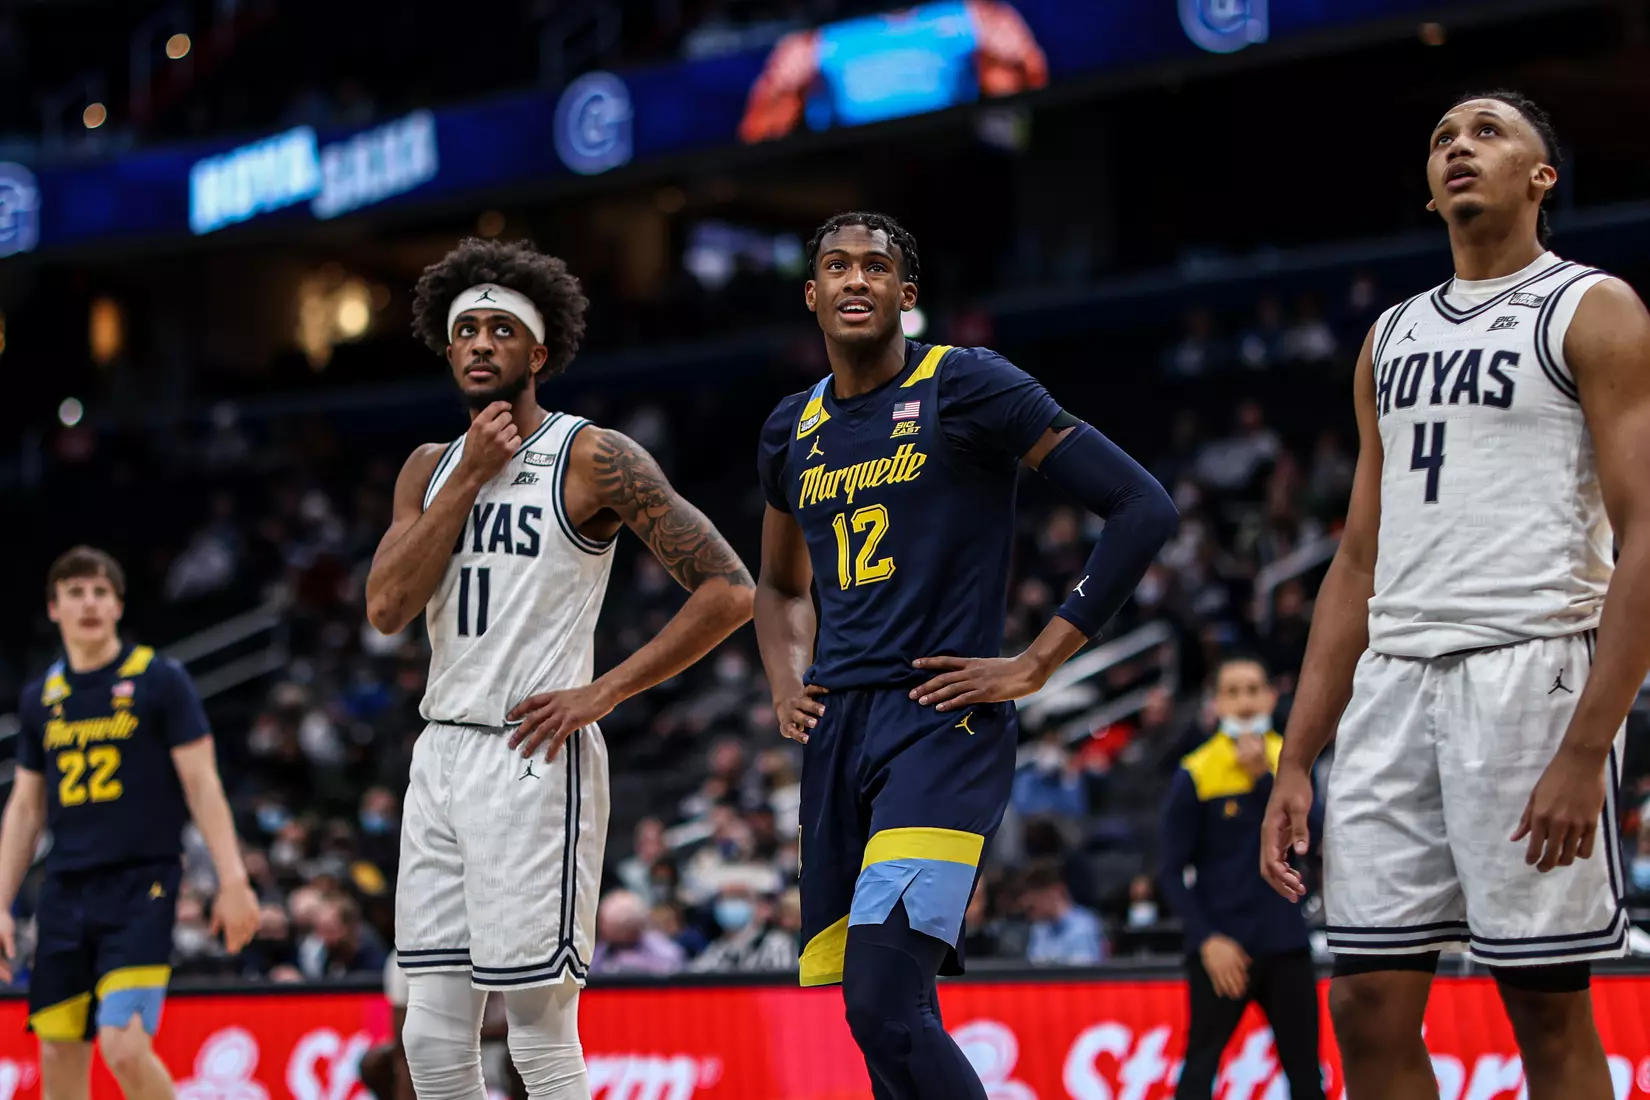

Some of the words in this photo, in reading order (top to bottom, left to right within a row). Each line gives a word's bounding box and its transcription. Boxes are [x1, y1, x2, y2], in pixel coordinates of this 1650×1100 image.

[1490, 321, 1520, 329] EAST
[1378, 348, 1520, 416] HOYAS
[892, 426, 921, 436] EAST
[896, 421, 916, 430] BIG
[799, 443, 928, 509] Marquette
[1409, 421, 1447, 504] 4
[452, 502, 543, 557] YAS
[832, 503, 897, 591] 12
[457, 566, 491, 637] 11
[56, 744, 124, 807] 22
